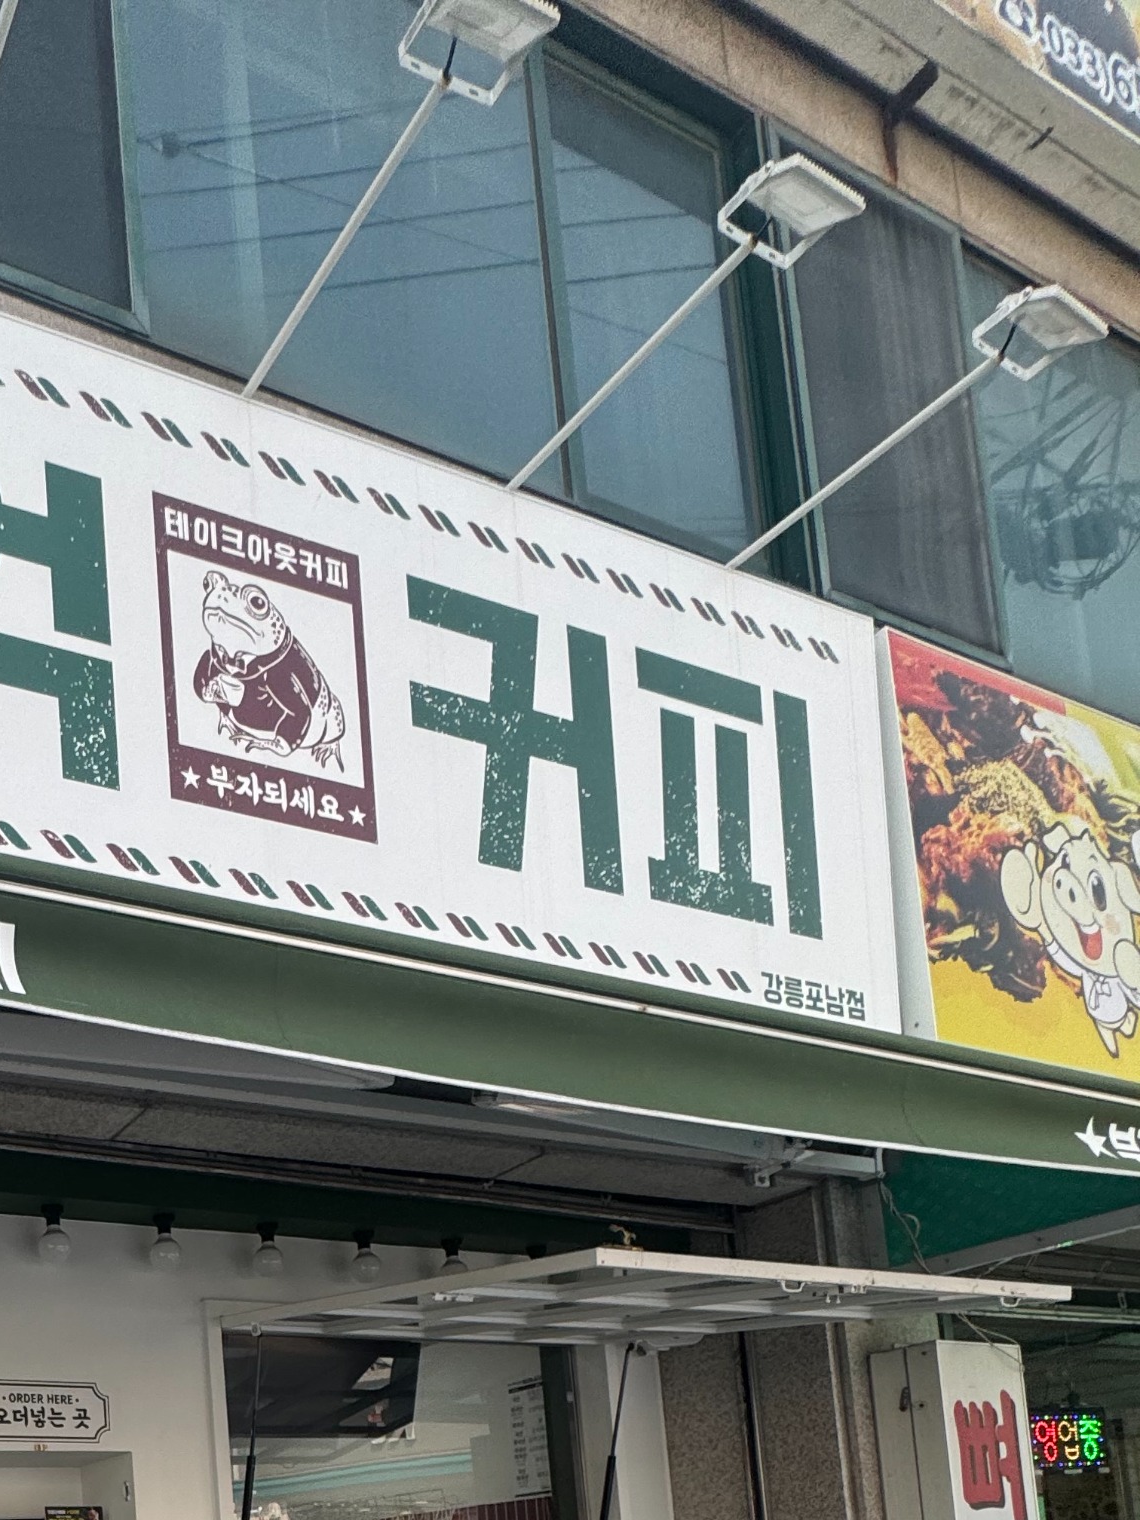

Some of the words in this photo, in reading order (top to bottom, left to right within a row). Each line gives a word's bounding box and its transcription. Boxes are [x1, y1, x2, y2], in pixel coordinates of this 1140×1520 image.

[164, 507, 348, 590] 테이크아웃커피
[407, 573, 823, 938] 커피
[207, 765, 344, 820] 부자되세요
[761, 971, 865, 1020] 강릉포남점
[8, 1393, 44, 1404] ORDER
[47, 1394, 73, 1405] HERE
[73, 1408, 91, 1430] 곳
[1035, 1420, 1099, 1461] 영업중
